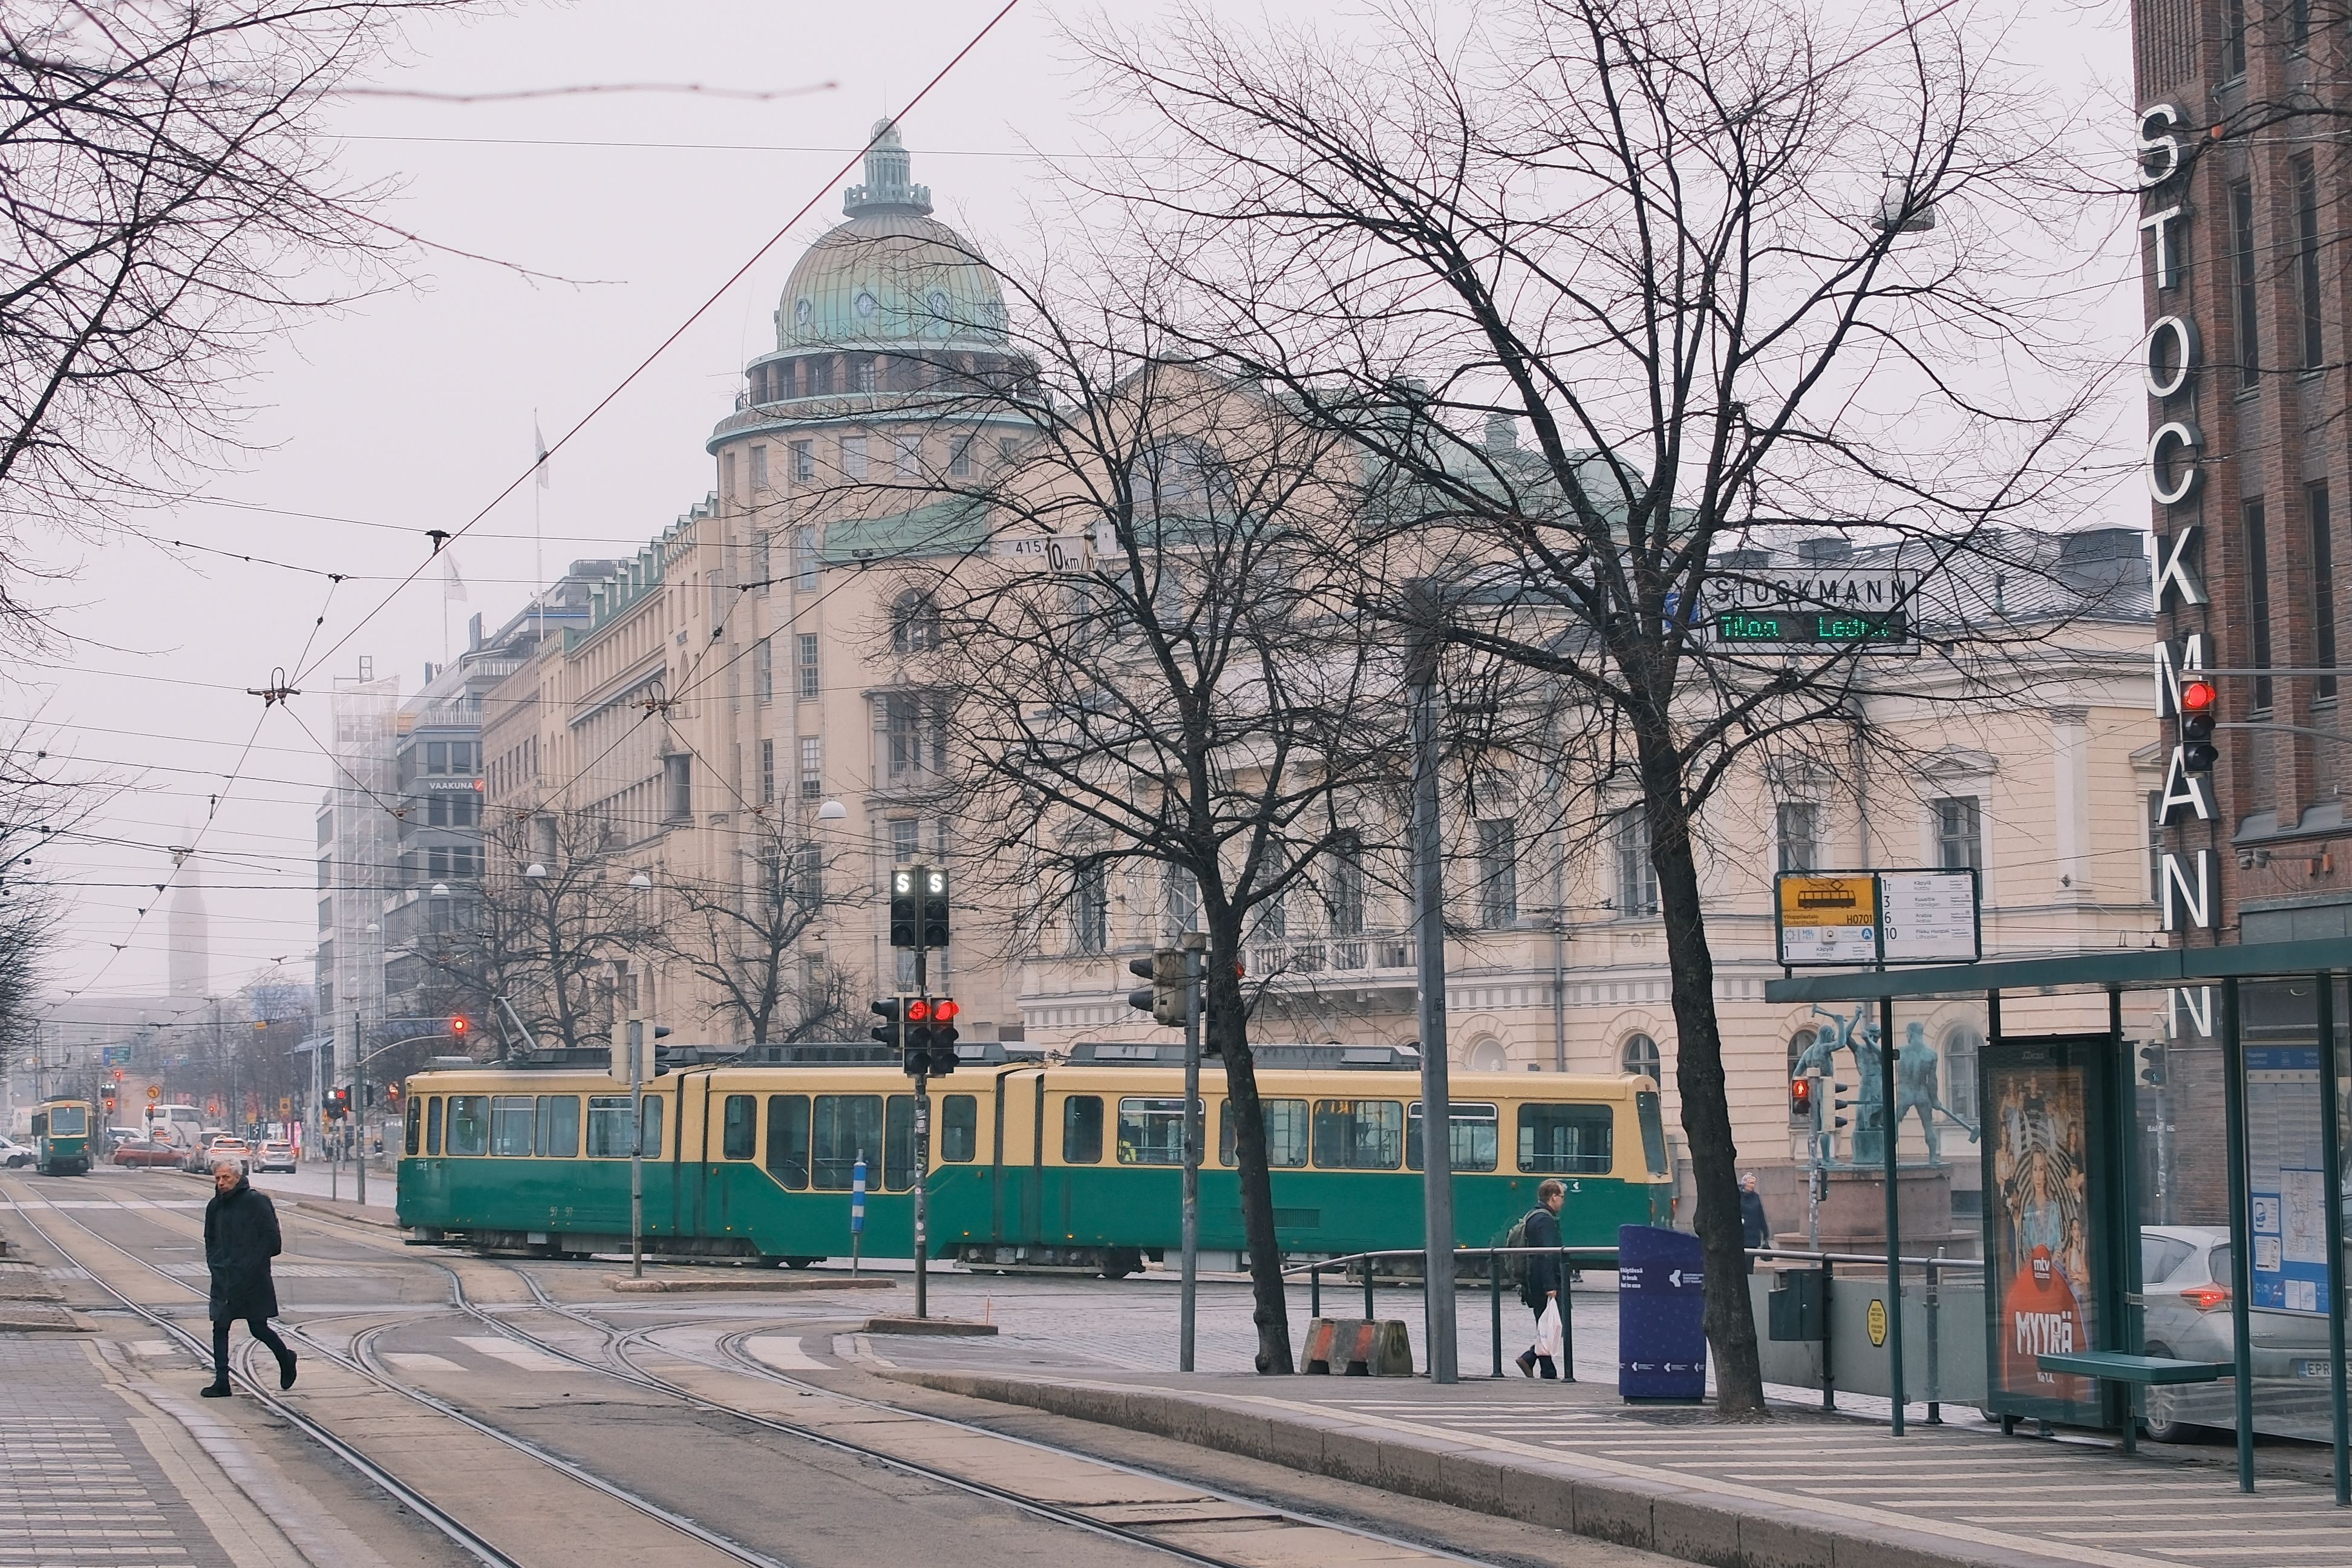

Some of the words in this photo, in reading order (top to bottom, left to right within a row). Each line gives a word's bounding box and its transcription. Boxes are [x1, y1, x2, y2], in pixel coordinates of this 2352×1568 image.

[1016, 540, 1042, 555] 415
[1045, 543, 1063, 571] 10
[1063, 552, 1095, 572] km/h
[2135, 103, 2213, 1039] STOCKMANN
[1884, 896, 1890, 908] 3
[1846, 914, 1873, 924] H0701
[1884, 912, 1892, 924] 6
[1863, 930, 1871, 938] A
[1884, 927, 1897, 940] 10
[1785, 945, 1789, 958] 1
[2033, 1256, 2050, 1272] mtv
[2015, 1310, 2073, 1355] MYYRÄ
